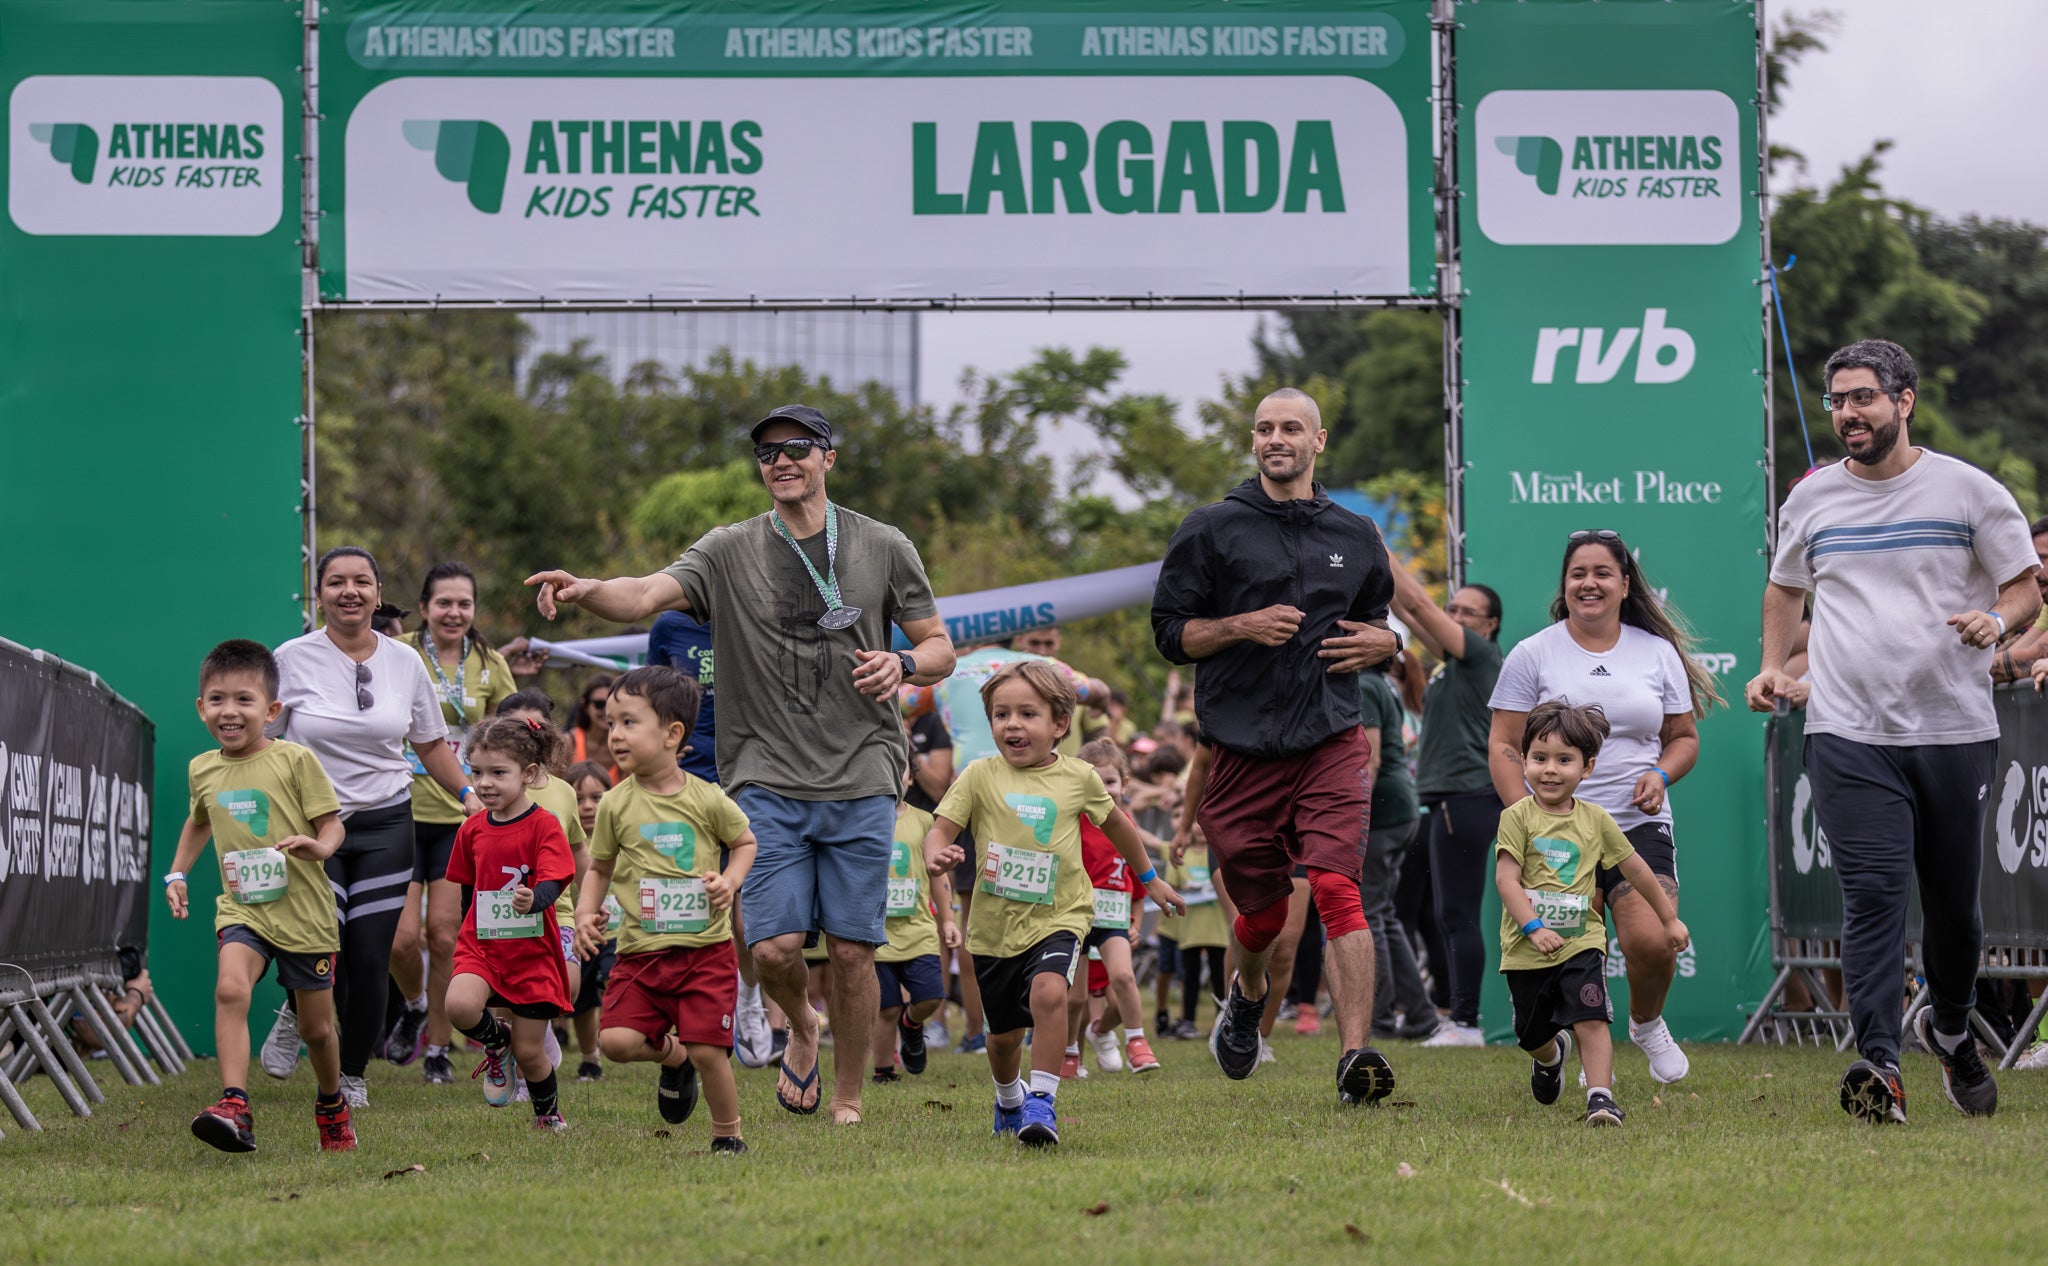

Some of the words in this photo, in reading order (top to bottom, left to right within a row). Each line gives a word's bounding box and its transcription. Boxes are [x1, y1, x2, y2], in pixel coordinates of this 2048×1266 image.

[364, 26, 493, 57] ATHENAS
[498, 26, 564, 57] KIDS
[569, 27, 675, 57] FASTER
[724, 27, 851, 58] ATHENAS
[856, 27, 923, 58] KIDS
[927, 26, 1033, 57] FASTER
[1081, 26, 1208, 57] ATHENAS
[1212, 26, 1278, 56] KIDS
[1283, 26, 1388, 56] FASTER
[108, 123, 264, 159] ATHENAS
[524, 120, 763, 175] ATHENAS
[1572, 135, 1722, 171] ATHENAS
[108, 165, 166, 188] KIDS
[175, 165, 262, 189] FASTER
[911, 119, 1346, 216] LARGADA
[524, 185, 614, 219] KIDS
[627, 184, 761, 219] FASTER
[1572, 177, 1628, 199] KIDS
[1637, 176, 1721, 199] FASTER
[1531, 307, 1696, 384] rvb
[1509, 470, 1625, 504] Market
[1633, 470, 1722, 504] Place
[943, 602, 1056, 643] THENAS
[240, 862, 284, 882] 9194
[1002, 861, 1047, 884] 9215
[660, 892, 708, 911] 9225
[1097, 900, 1124, 915] 9247
[1536, 903, 1579, 921] 9259
